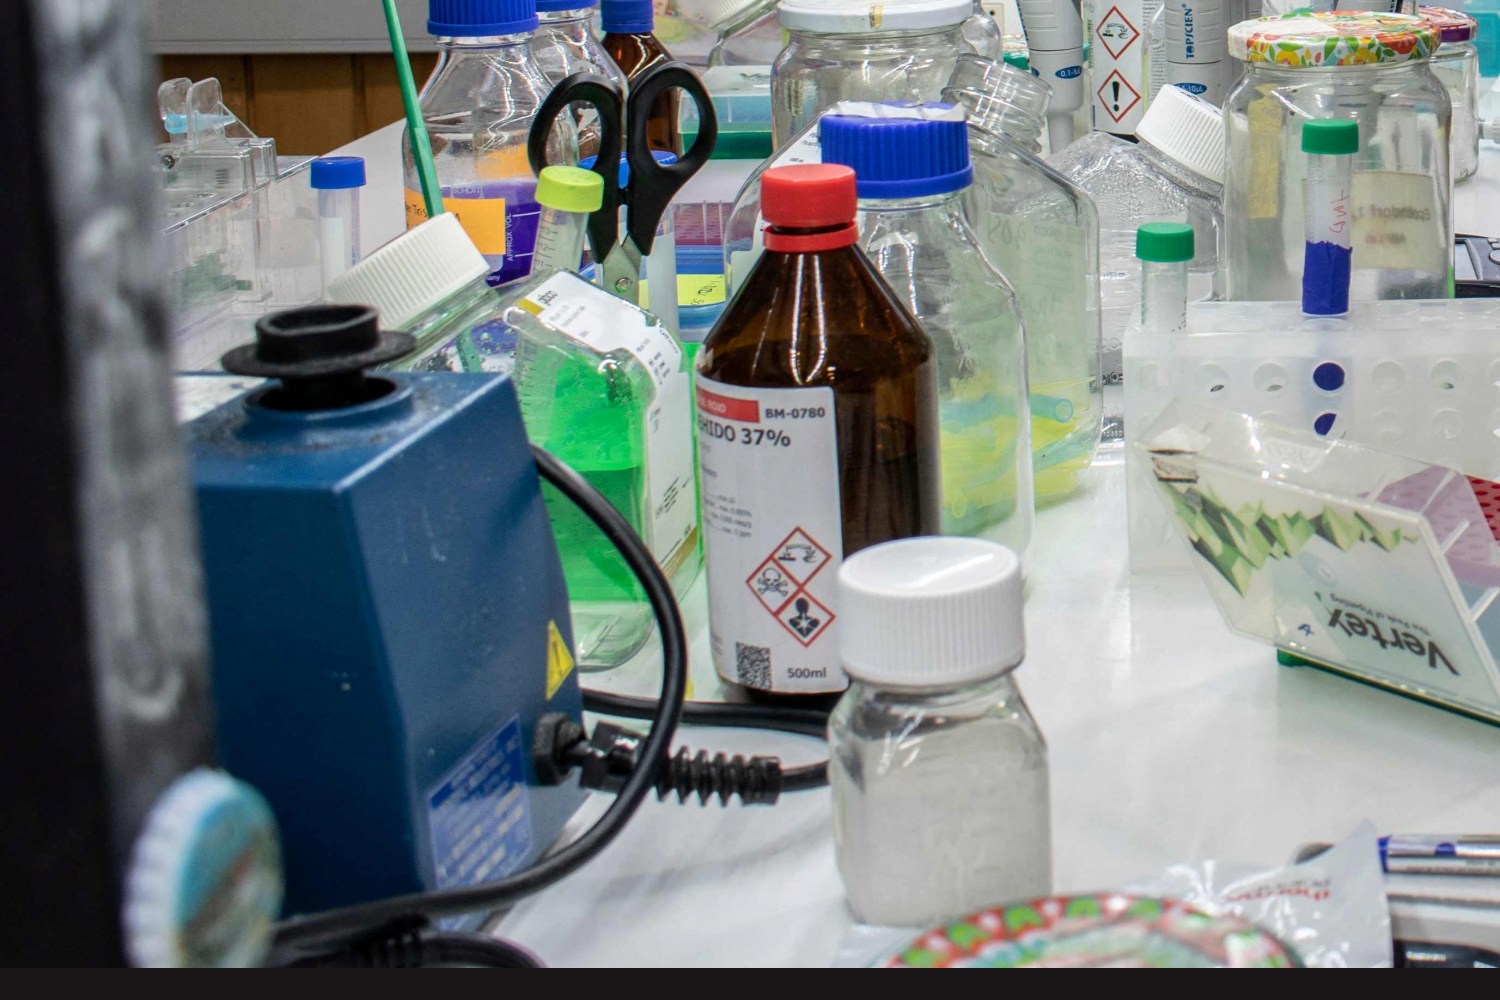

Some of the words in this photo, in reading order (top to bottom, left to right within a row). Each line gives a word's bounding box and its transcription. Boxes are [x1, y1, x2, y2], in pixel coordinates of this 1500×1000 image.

[765, 407, 826, 419] BM-0780
[741, 427, 791, 447] 37%
[1327, 606, 1460, 677] Vertex
[787, 667, 827, 679] 500ml
